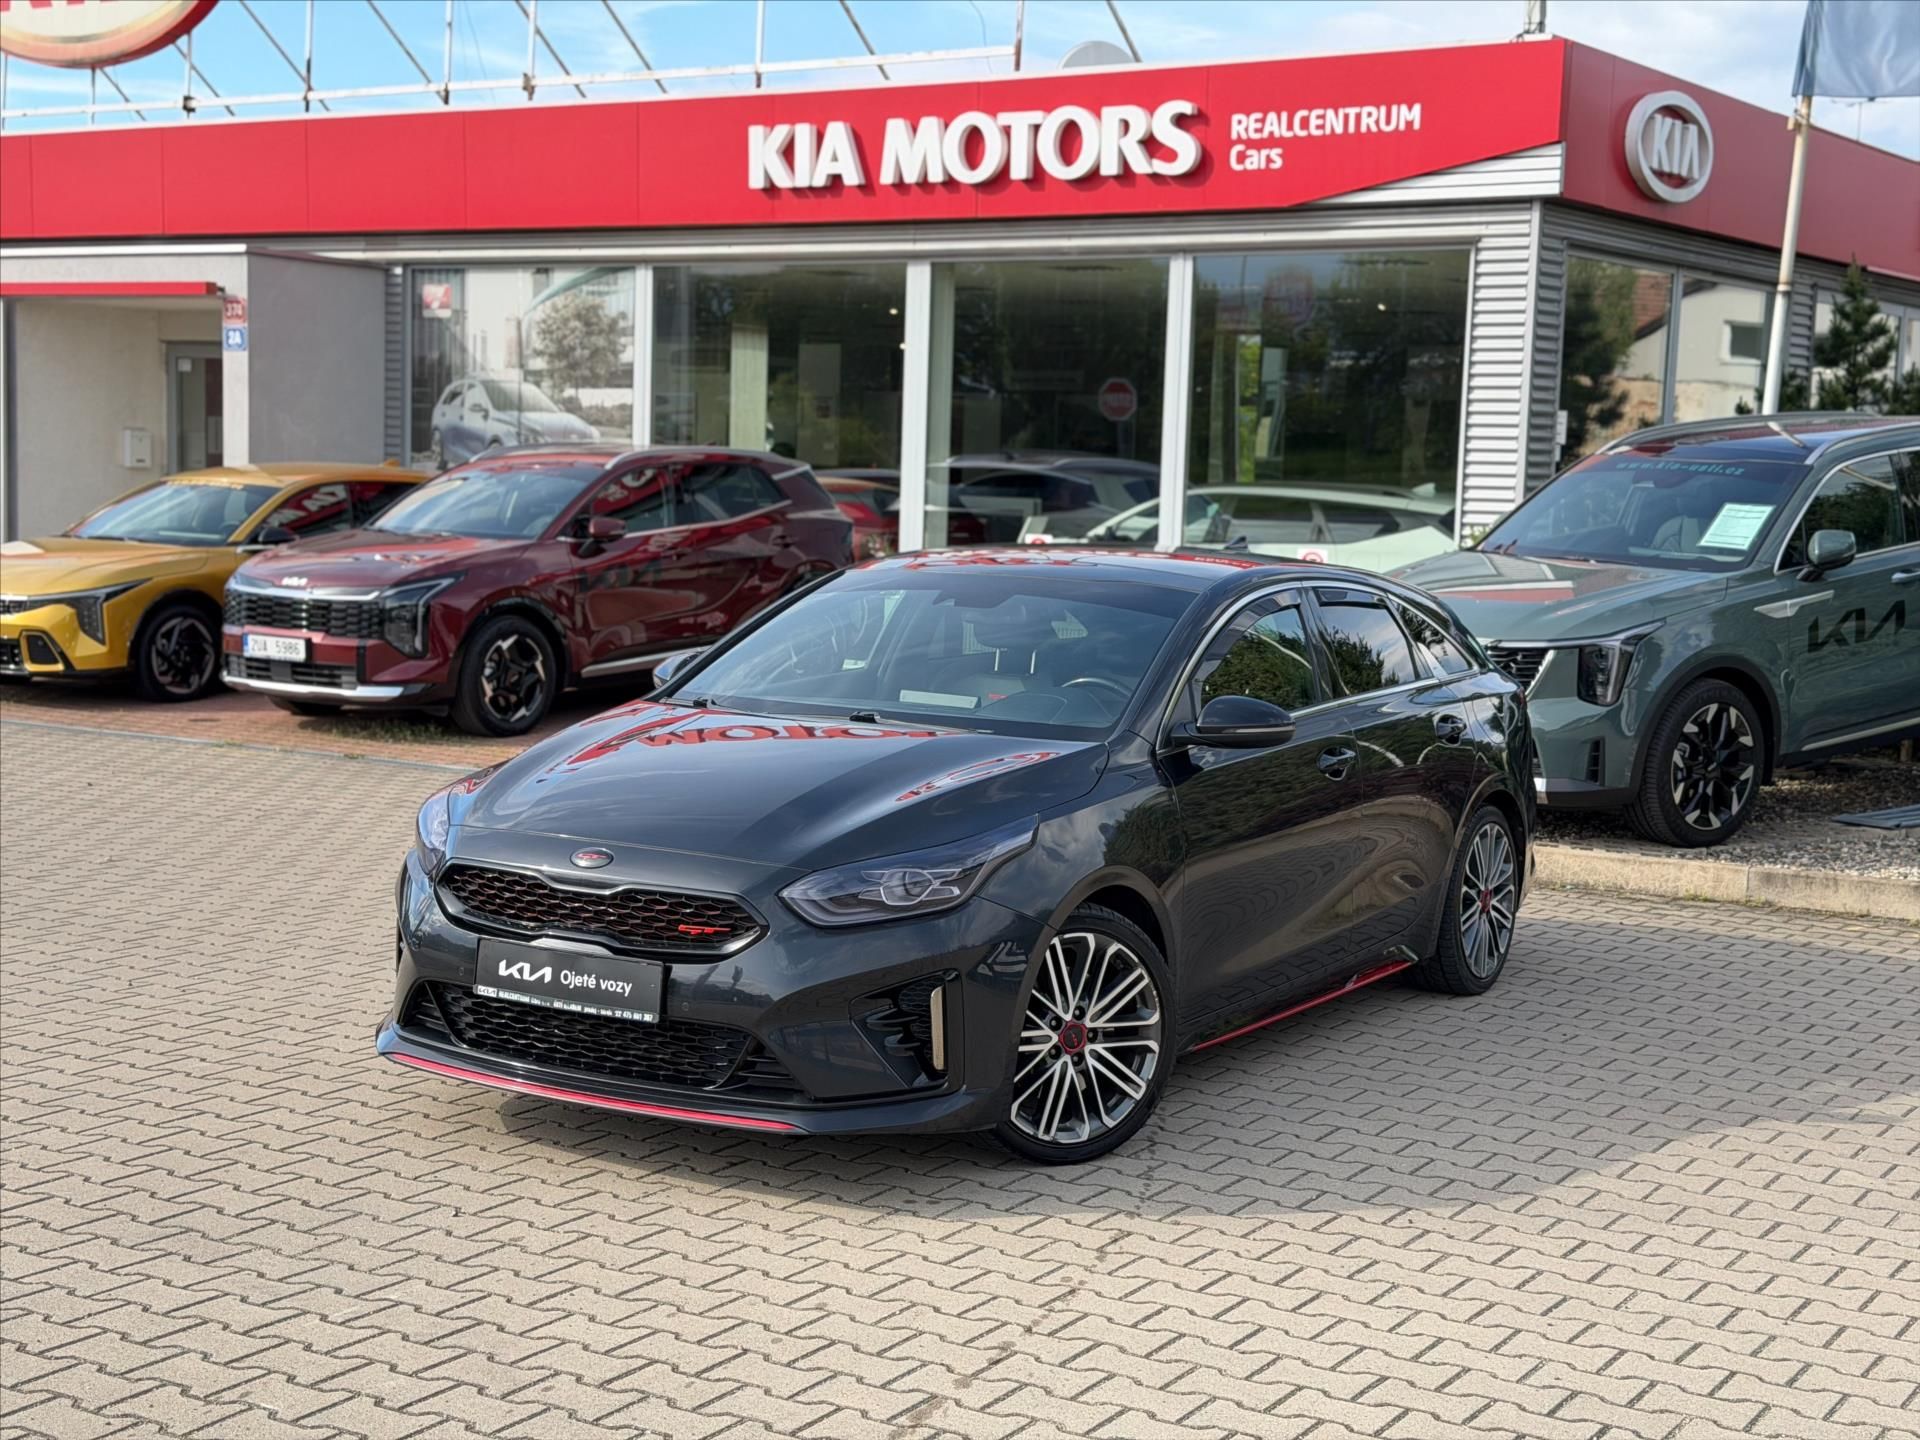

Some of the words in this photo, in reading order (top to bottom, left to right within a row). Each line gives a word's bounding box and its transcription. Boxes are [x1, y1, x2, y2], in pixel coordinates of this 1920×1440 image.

[748, 120, 867, 189] KIA
[879, 99, 1201, 186] MOTORS
[1230, 102, 1422, 141] REALCENTRUM
[1229, 143, 1284, 172] Cars
[1650, 112, 1701, 180] KIA
[1806, 599, 1906, 655] KIA
[498, 959, 553, 984] KIA
[560, 969, 597, 989] Ojeté
[599, 978, 633, 998] vozy
